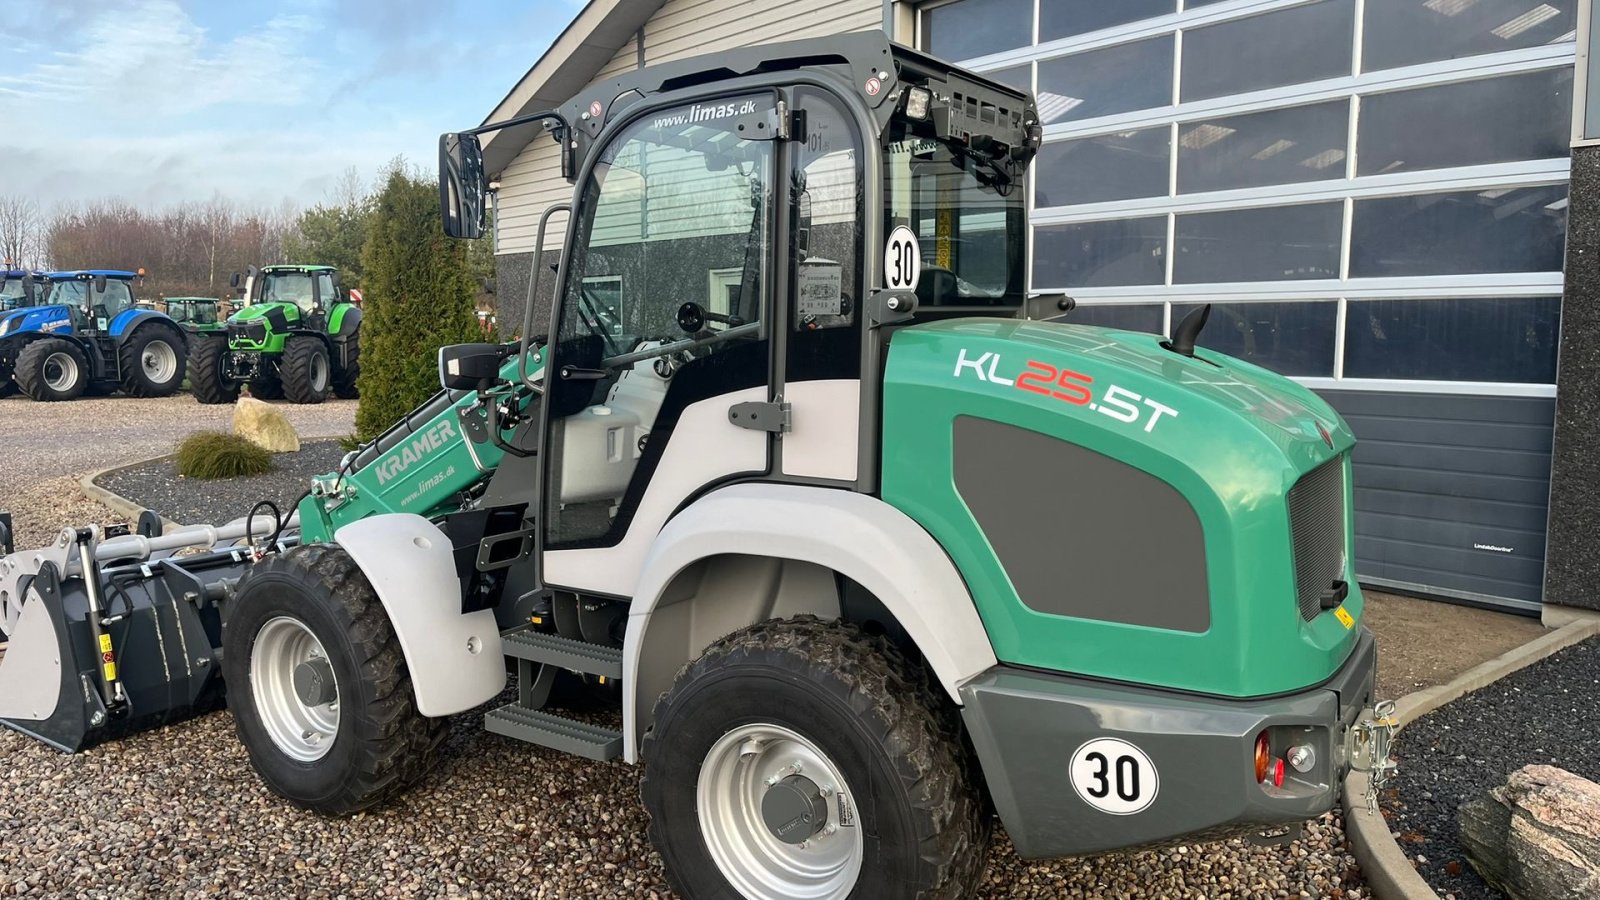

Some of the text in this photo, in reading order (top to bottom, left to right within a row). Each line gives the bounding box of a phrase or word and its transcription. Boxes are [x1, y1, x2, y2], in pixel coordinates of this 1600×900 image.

[653, 100, 757, 128] www.limas.dk
[807, 132, 822, 152] 101
[891, 240, 914, 287] 30
[953, 348, 1180, 433] KL25.5T
[375, 419, 456, 486] KRAMER
[400, 465, 456, 506] www.limas.dk
[1085, 751, 1140, 802] 30
